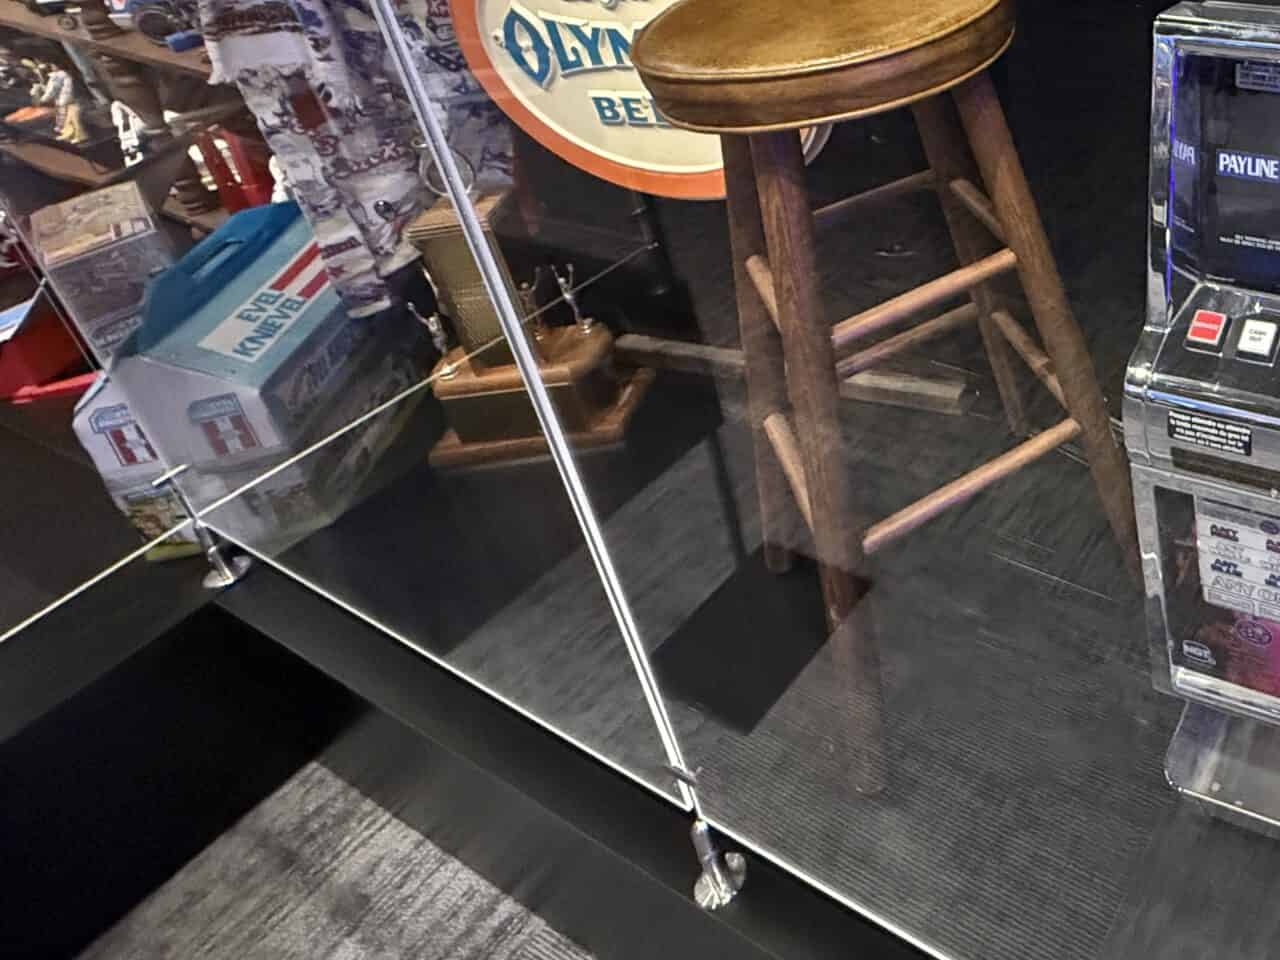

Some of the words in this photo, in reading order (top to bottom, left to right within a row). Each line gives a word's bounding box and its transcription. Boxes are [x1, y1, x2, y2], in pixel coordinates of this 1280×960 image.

[503, 6, 645, 86] OLYM
[1218, 152, 1280, 180] PAYLINE
[233, 297, 306, 357] KNIEVEL
[237, 292, 285, 323] EVEL
